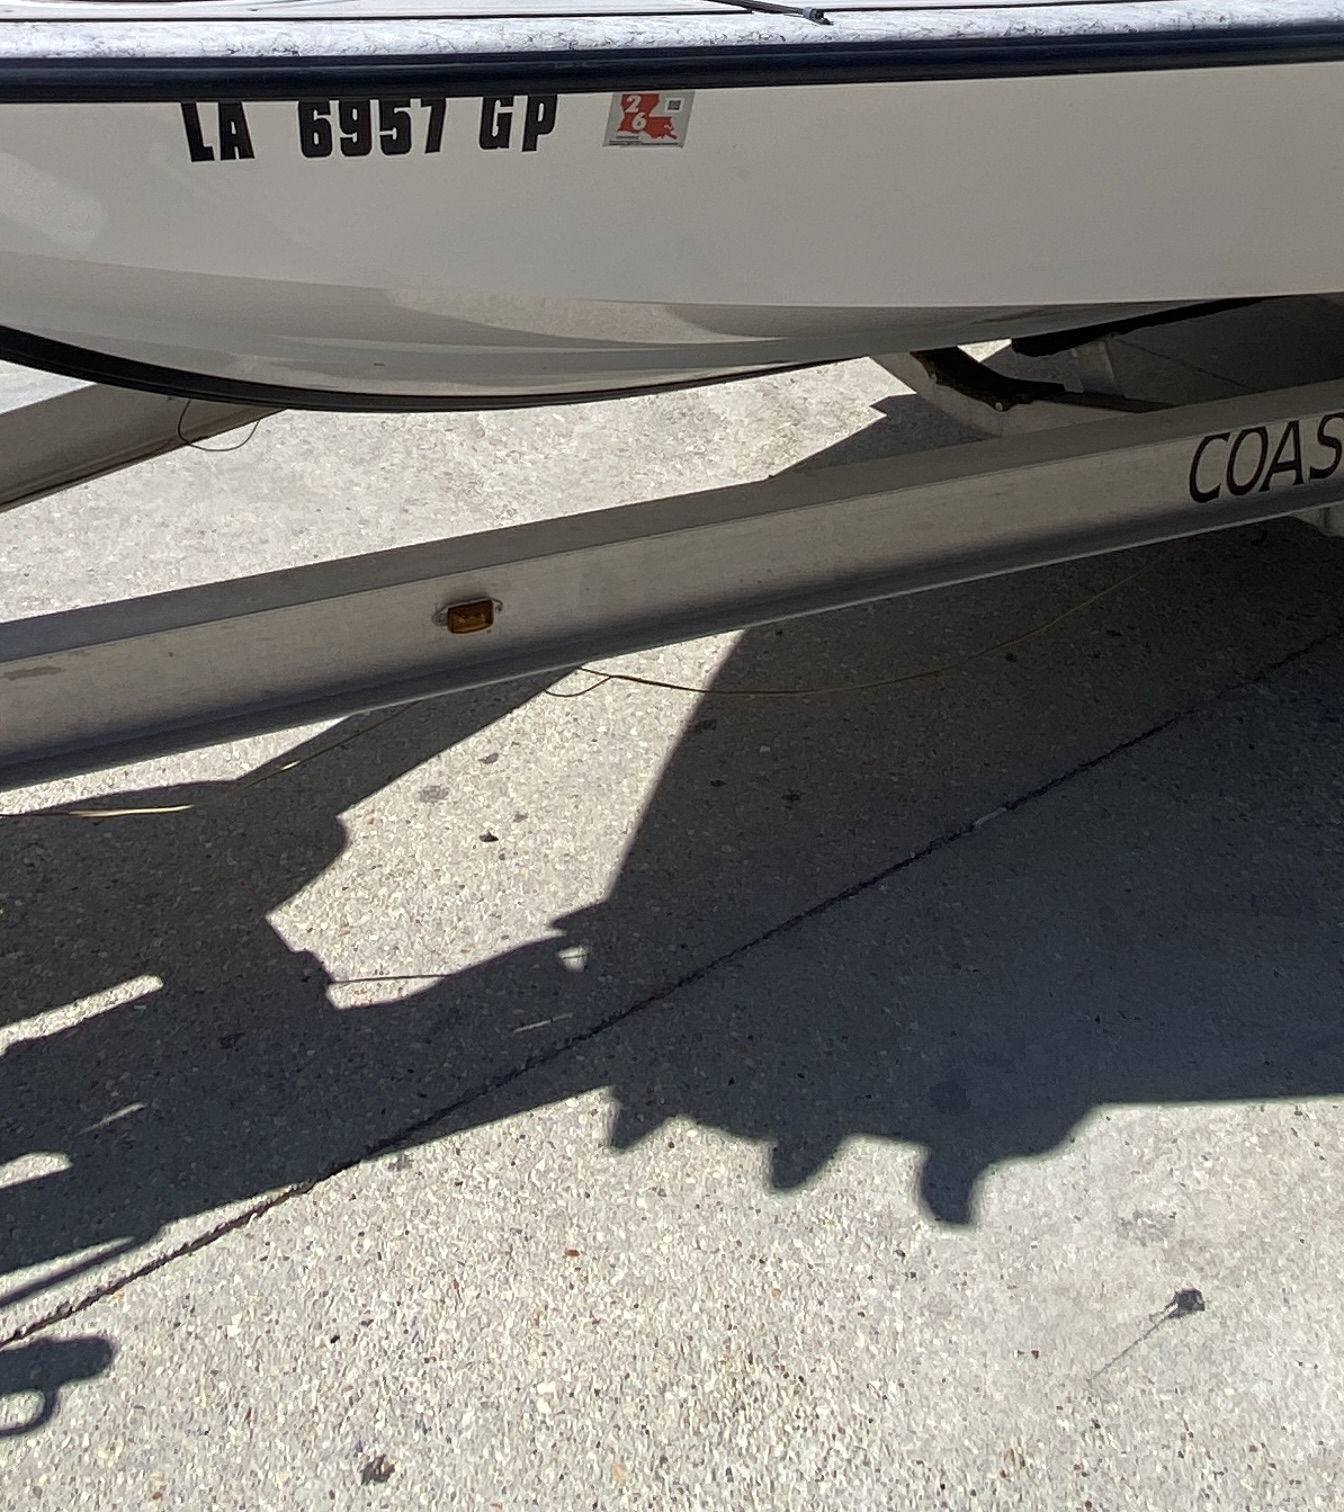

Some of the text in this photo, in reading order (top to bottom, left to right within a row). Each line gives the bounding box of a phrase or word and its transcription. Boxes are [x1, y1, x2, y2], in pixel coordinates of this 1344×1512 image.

[180, 94, 557, 162] LA 6957 GP
